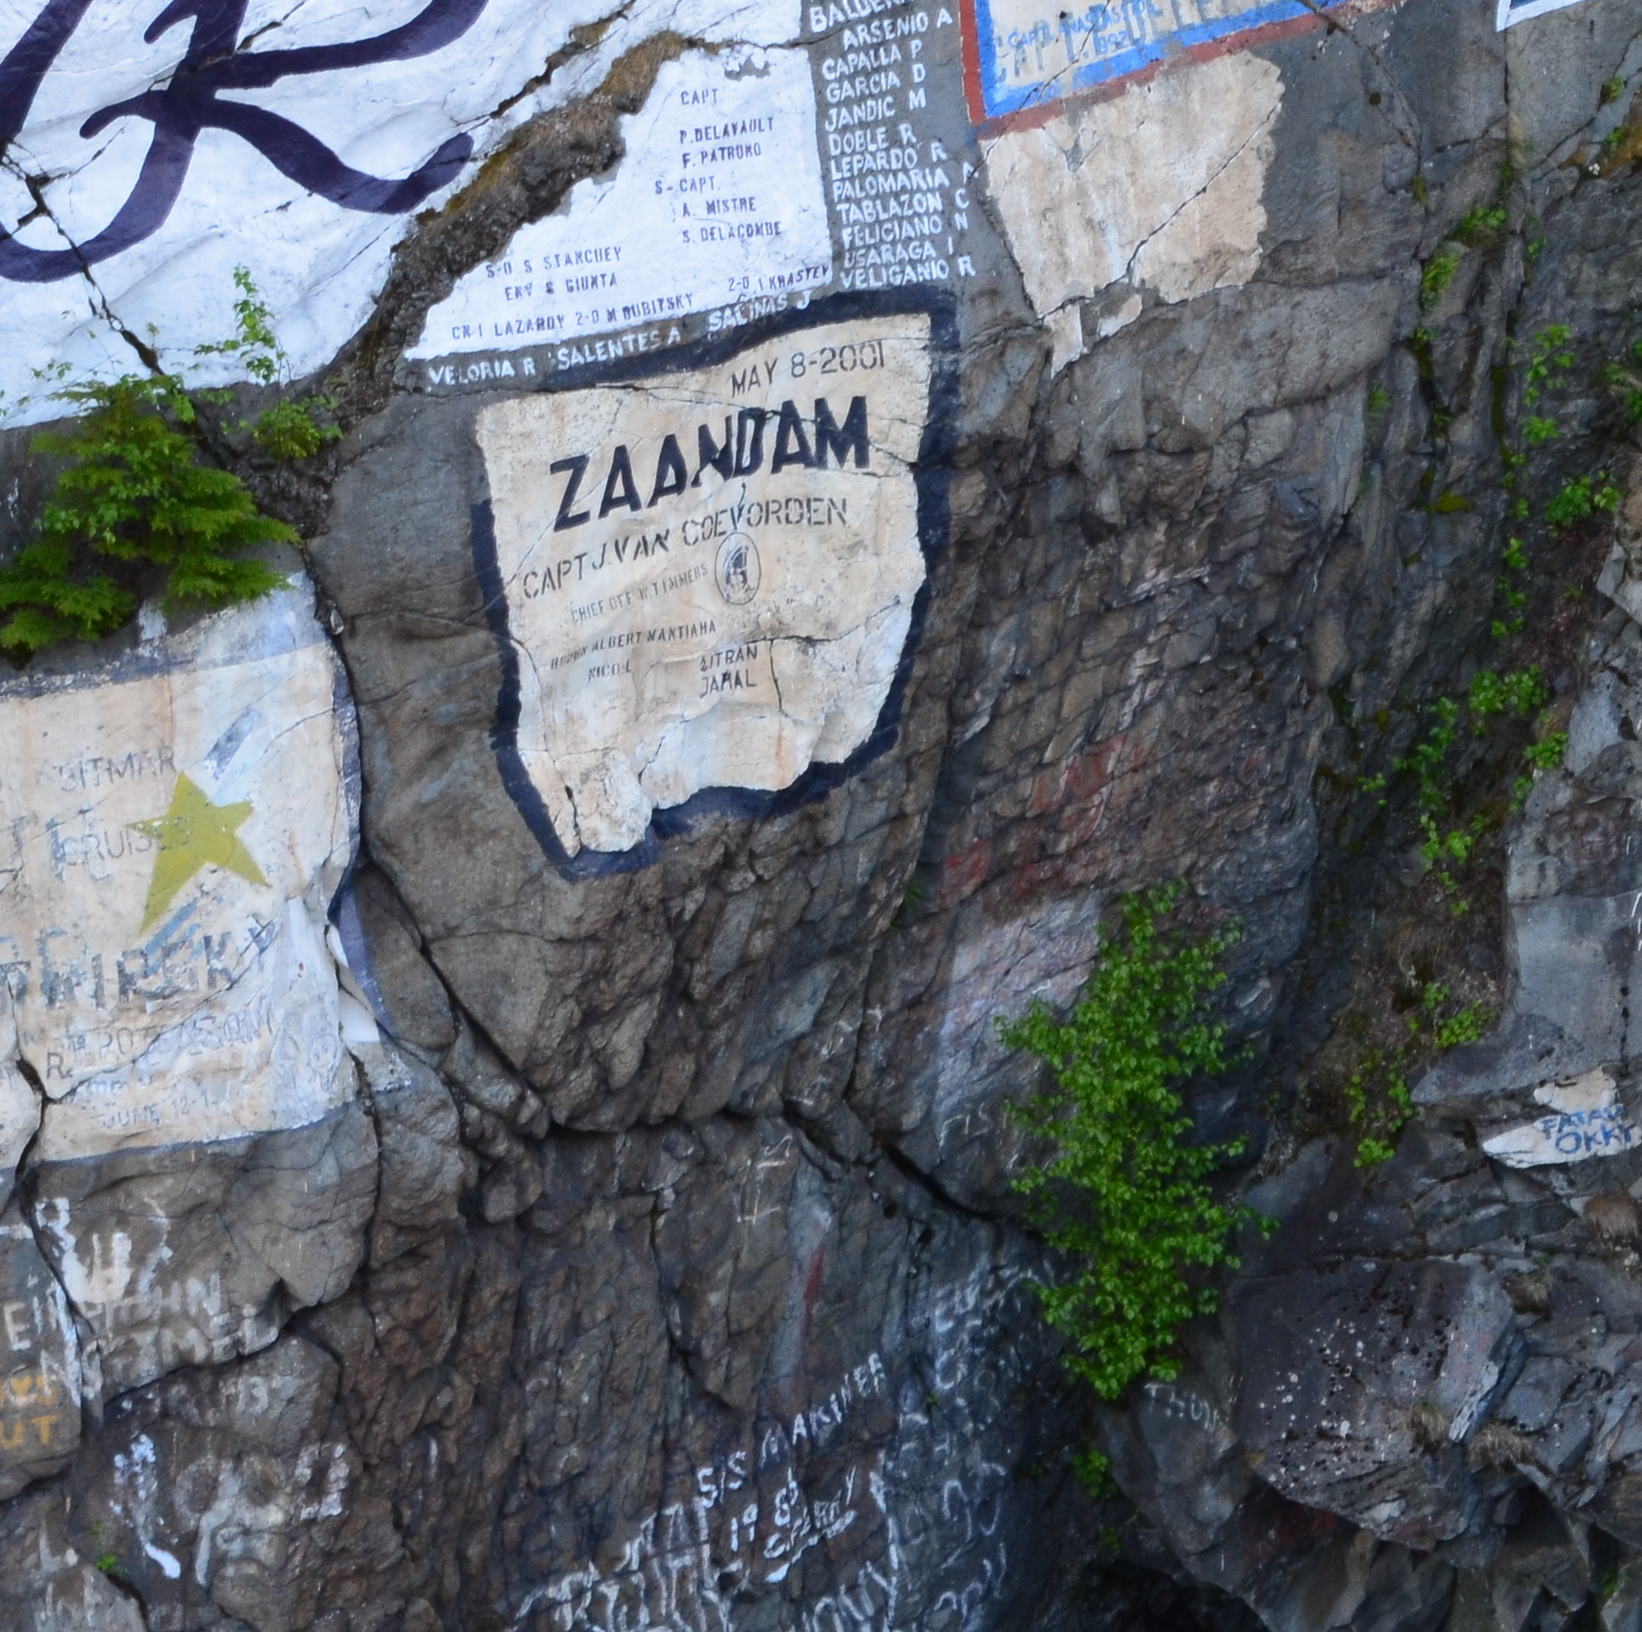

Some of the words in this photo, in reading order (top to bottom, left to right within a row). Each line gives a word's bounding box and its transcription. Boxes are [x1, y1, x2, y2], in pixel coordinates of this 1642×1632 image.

[842, 12, 928, 47] ARSENIO
[822, 46, 901, 81] CAPALLA
[826, 72, 901, 105] GARCIA
[825, 96, 895, 132] JANDIC
[829, 128, 890, 157] DOBLE
[829, 148, 918, 179] LEPARDO
[832, 169, 950, 202] PALOMARIA
[706, 196, 757, 214] MISTRE
[836, 193, 942, 226] TABLAZON
[842, 217, 942, 248] FELICIANO
[839, 260, 950, 289] VELIGANIO
[429, 361, 515, 385] VELORIA
[557, 332, 661, 370] SALENTES
[731, 358, 776, 399] MAY
[789, 340, 886, 380] 8-2001
[549, 395, 870, 533] ZAANDAM
[682, 496, 847, 547] COEVORDEN
[591, 632, 642, 653] ALBERT
